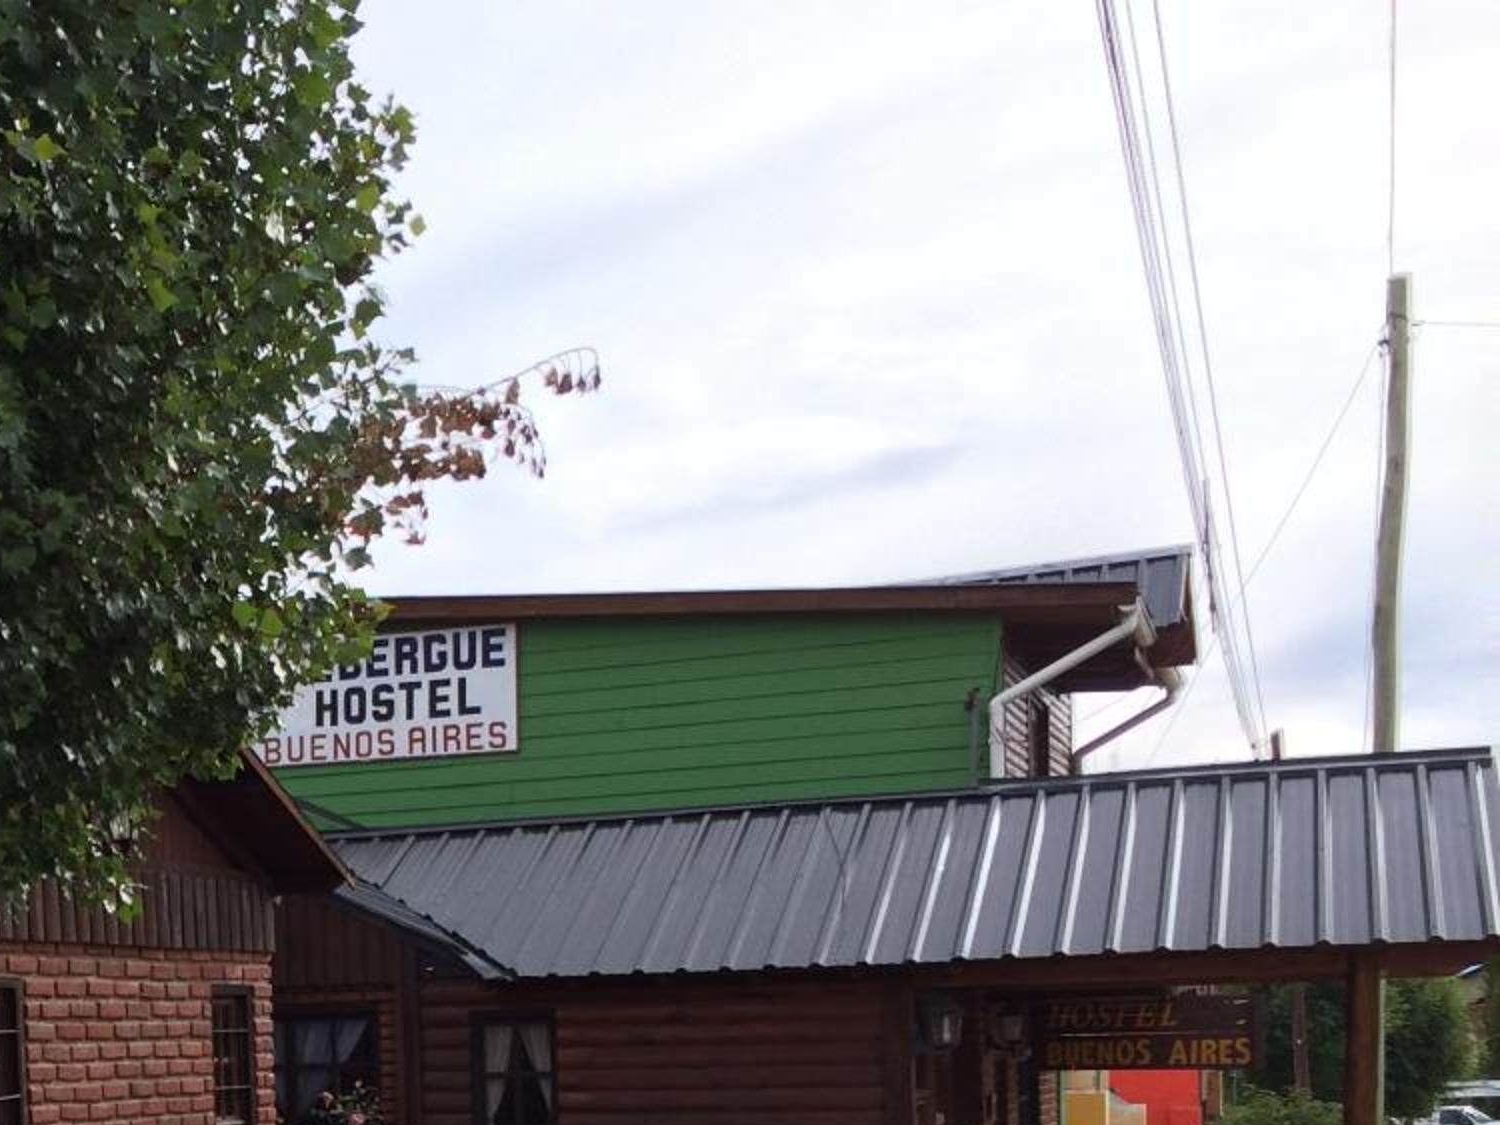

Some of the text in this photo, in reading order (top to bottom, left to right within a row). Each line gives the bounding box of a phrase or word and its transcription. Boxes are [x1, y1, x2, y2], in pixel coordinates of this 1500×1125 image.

[322, 627, 506, 682] ERGUE
[315, 677, 482, 727] HOSTEL
[265, 721, 507, 764] BUENOS AIRES
[1050, 996, 1179, 1027] HOSTEL
[1047, 1037, 1251, 1066] BUENOS AIRES
